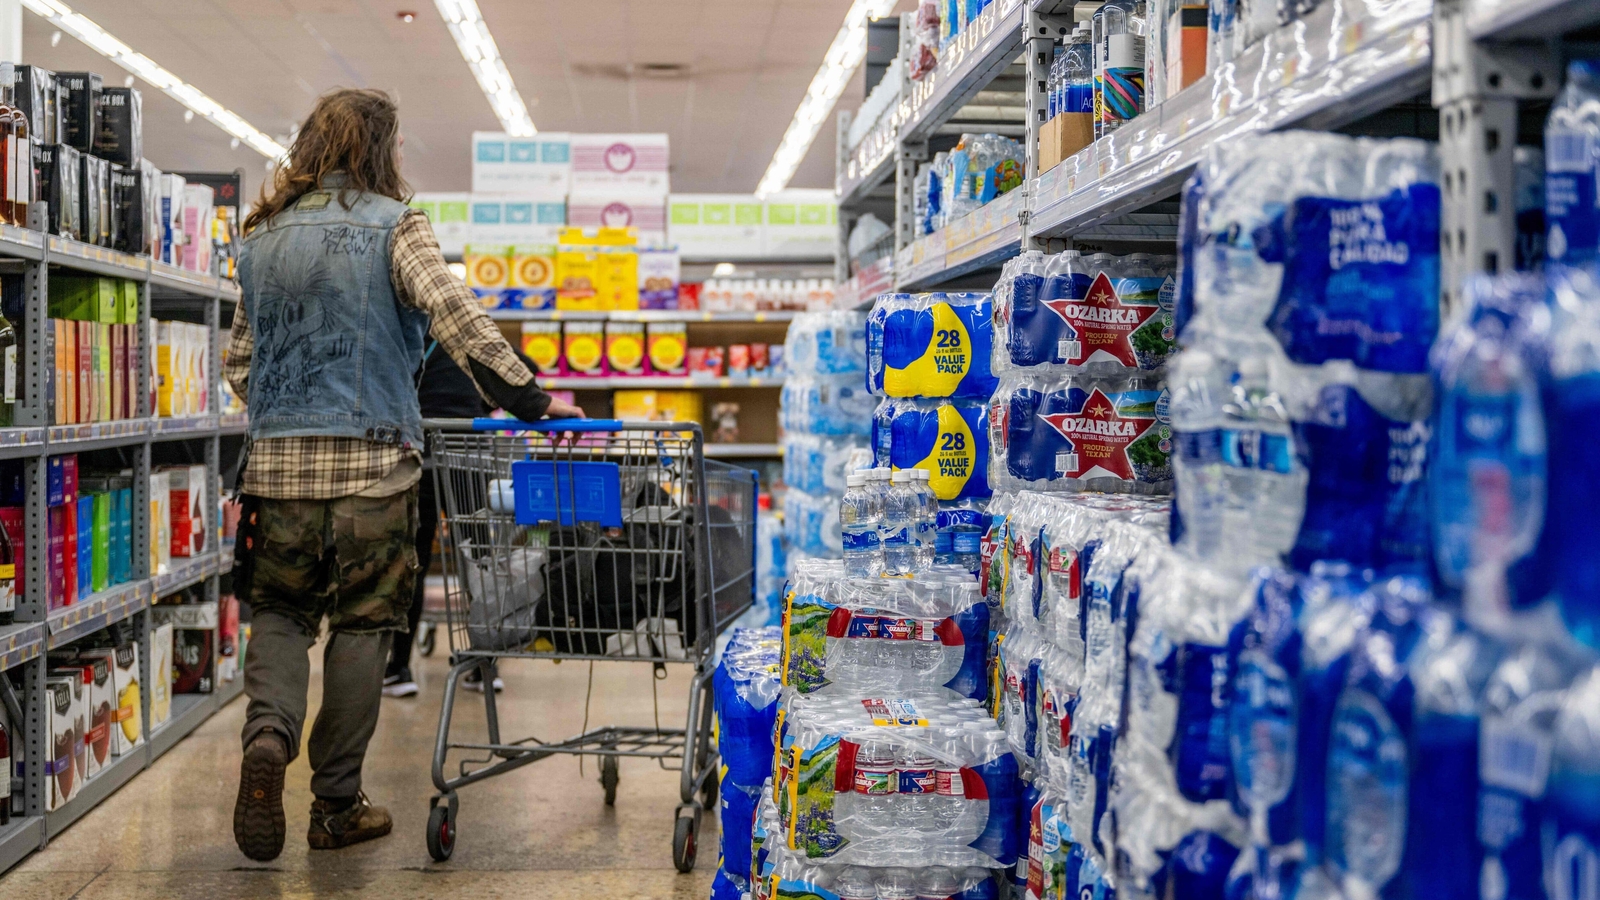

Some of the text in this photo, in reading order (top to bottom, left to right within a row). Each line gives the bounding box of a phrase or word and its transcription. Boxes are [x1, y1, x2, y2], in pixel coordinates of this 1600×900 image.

[111, 95, 125, 106] BOX
[1065, 304, 1139, 323] OZARKA
[1084, 321, 1100, 329] NATURAL
[937, 329, 961, 347] 28
[1085, 332, 1118, 340] PROUDLY
[934, 354, 966, 365] VALUE
[937, 364, 964, 374] PACK
[1062, 418, 1137, 436] OZARKA
[941, 432, 966, 450] 28
[1083, 443, 1116, 451] PROUDLY
[938, 457, 969, 467] VALUE
[940, 467, 967, 477] PACK
[153, 610, 209, 624] RANZIA
[116, 648, 134, 662] VELLA
[94, 664, 108, 678] VELLA
[54, 689, 71, 707] VELLA
